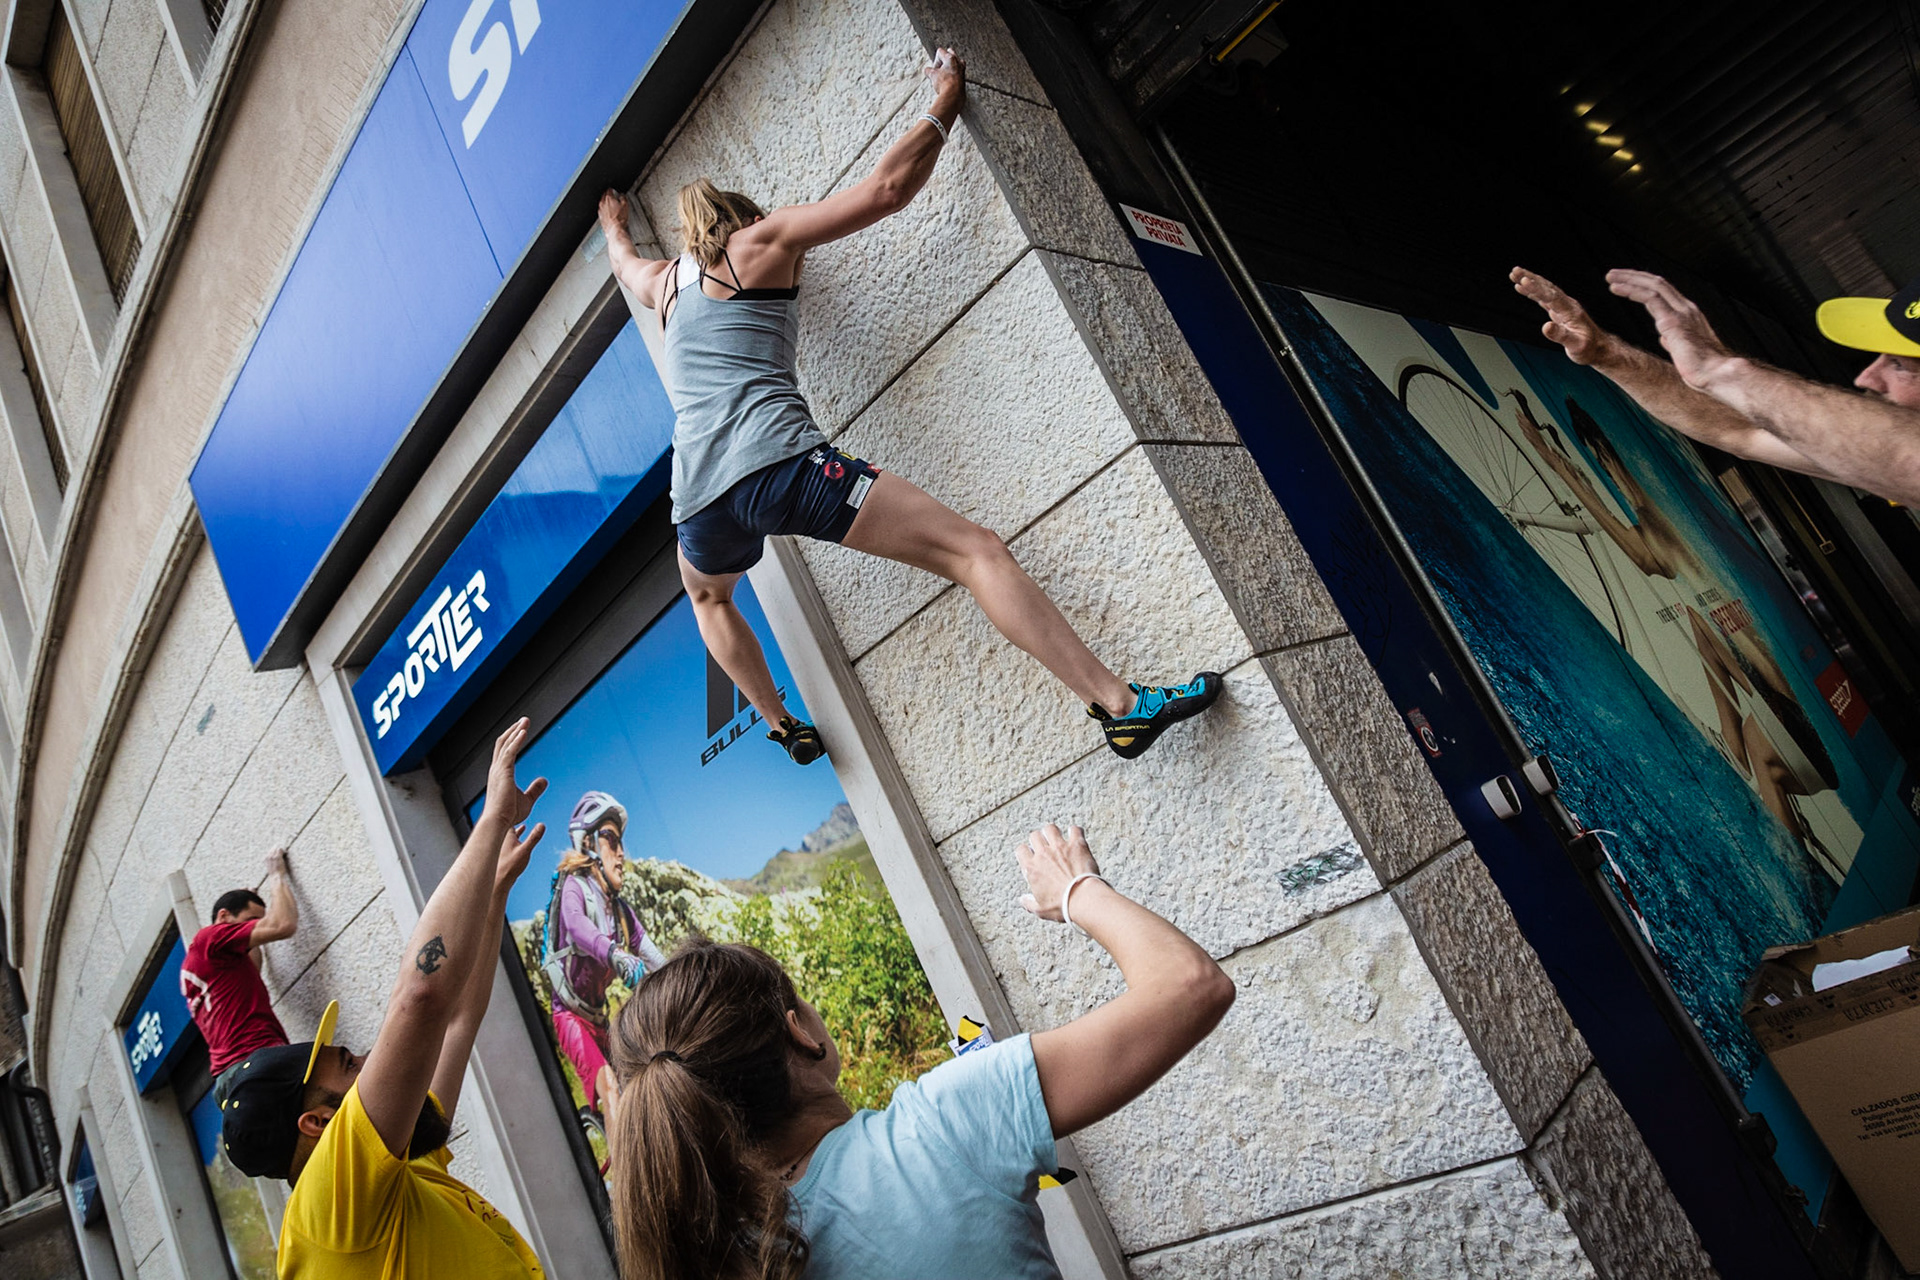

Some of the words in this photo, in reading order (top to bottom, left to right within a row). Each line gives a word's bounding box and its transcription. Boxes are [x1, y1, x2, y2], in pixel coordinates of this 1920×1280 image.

[1145, 226, 1187, 248] PRIVATA
[372, 569, 491, 740] SPORTLER
[1114, 724, 1151, 732] SPORTIVA
[1851, 1098, 1900, 1116] CALZADOS
